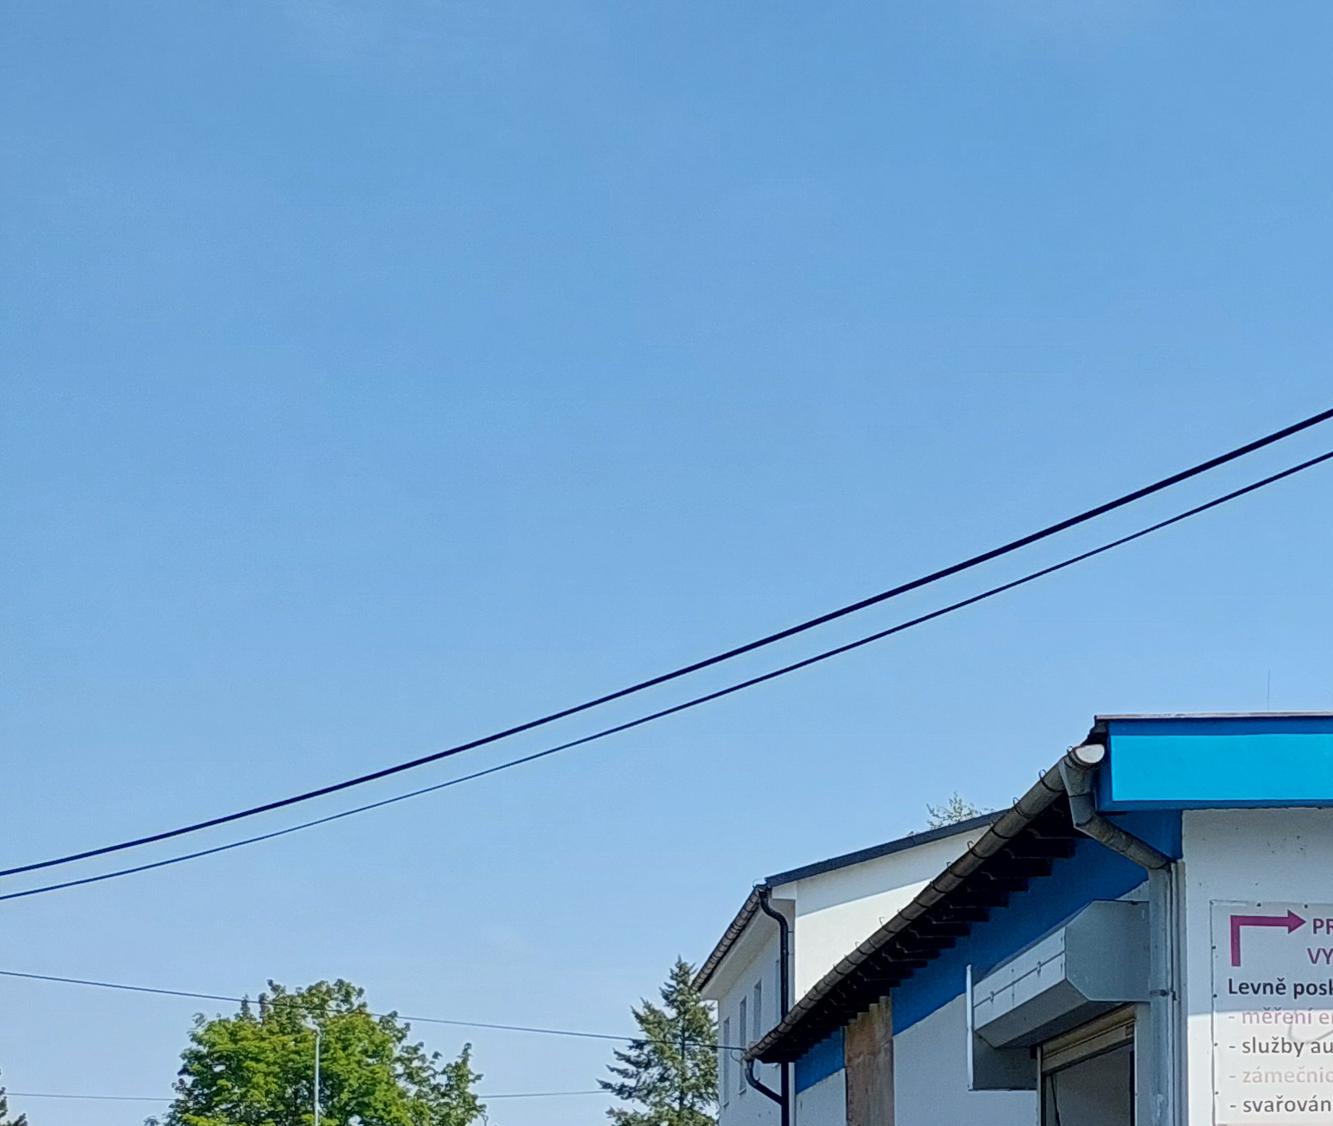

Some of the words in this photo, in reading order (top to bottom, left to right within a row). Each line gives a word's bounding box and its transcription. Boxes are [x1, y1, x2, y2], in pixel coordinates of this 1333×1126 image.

[1228, 978, 1286, 996] Levně
[1242, 1007, 1313, 1025] měření
[1242, 1037, 1304, 1057] služby
